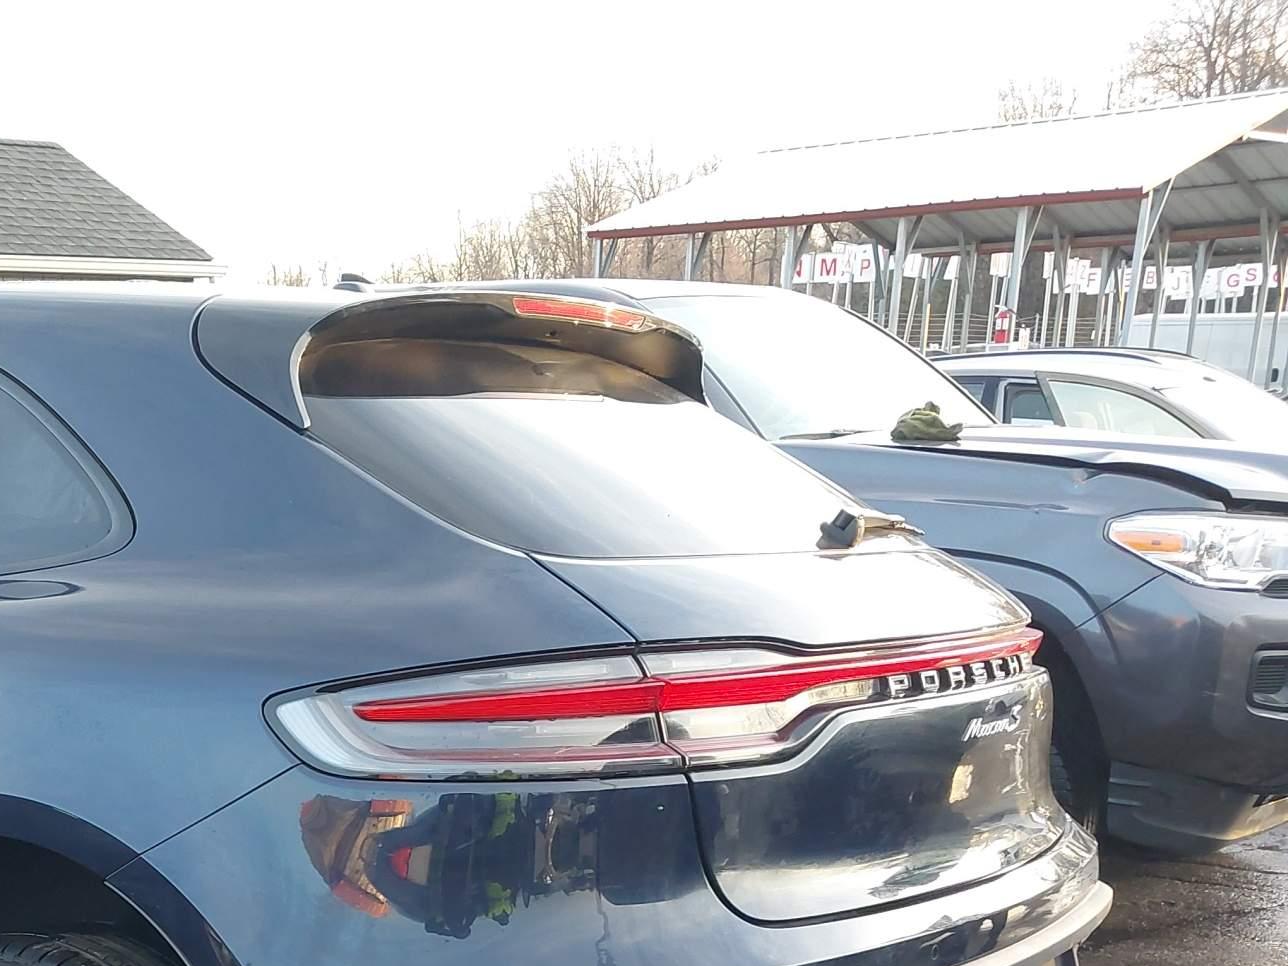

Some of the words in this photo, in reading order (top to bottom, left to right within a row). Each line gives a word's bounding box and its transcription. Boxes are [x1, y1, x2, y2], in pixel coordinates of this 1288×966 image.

[820, 258, 837, 277] M
[859, 258, 871, 277] P
[1245, 268, 1258, 282] S
[1086, 272, 1097, 289] F
[1146, 271, 1156, 285] B
[1226, 273, 1241, 288] G
[888, 651, 1034, 700] PORSCHE
[962, 717, 1009, 742] Macan
[1006, 703, 1023, 732] S
